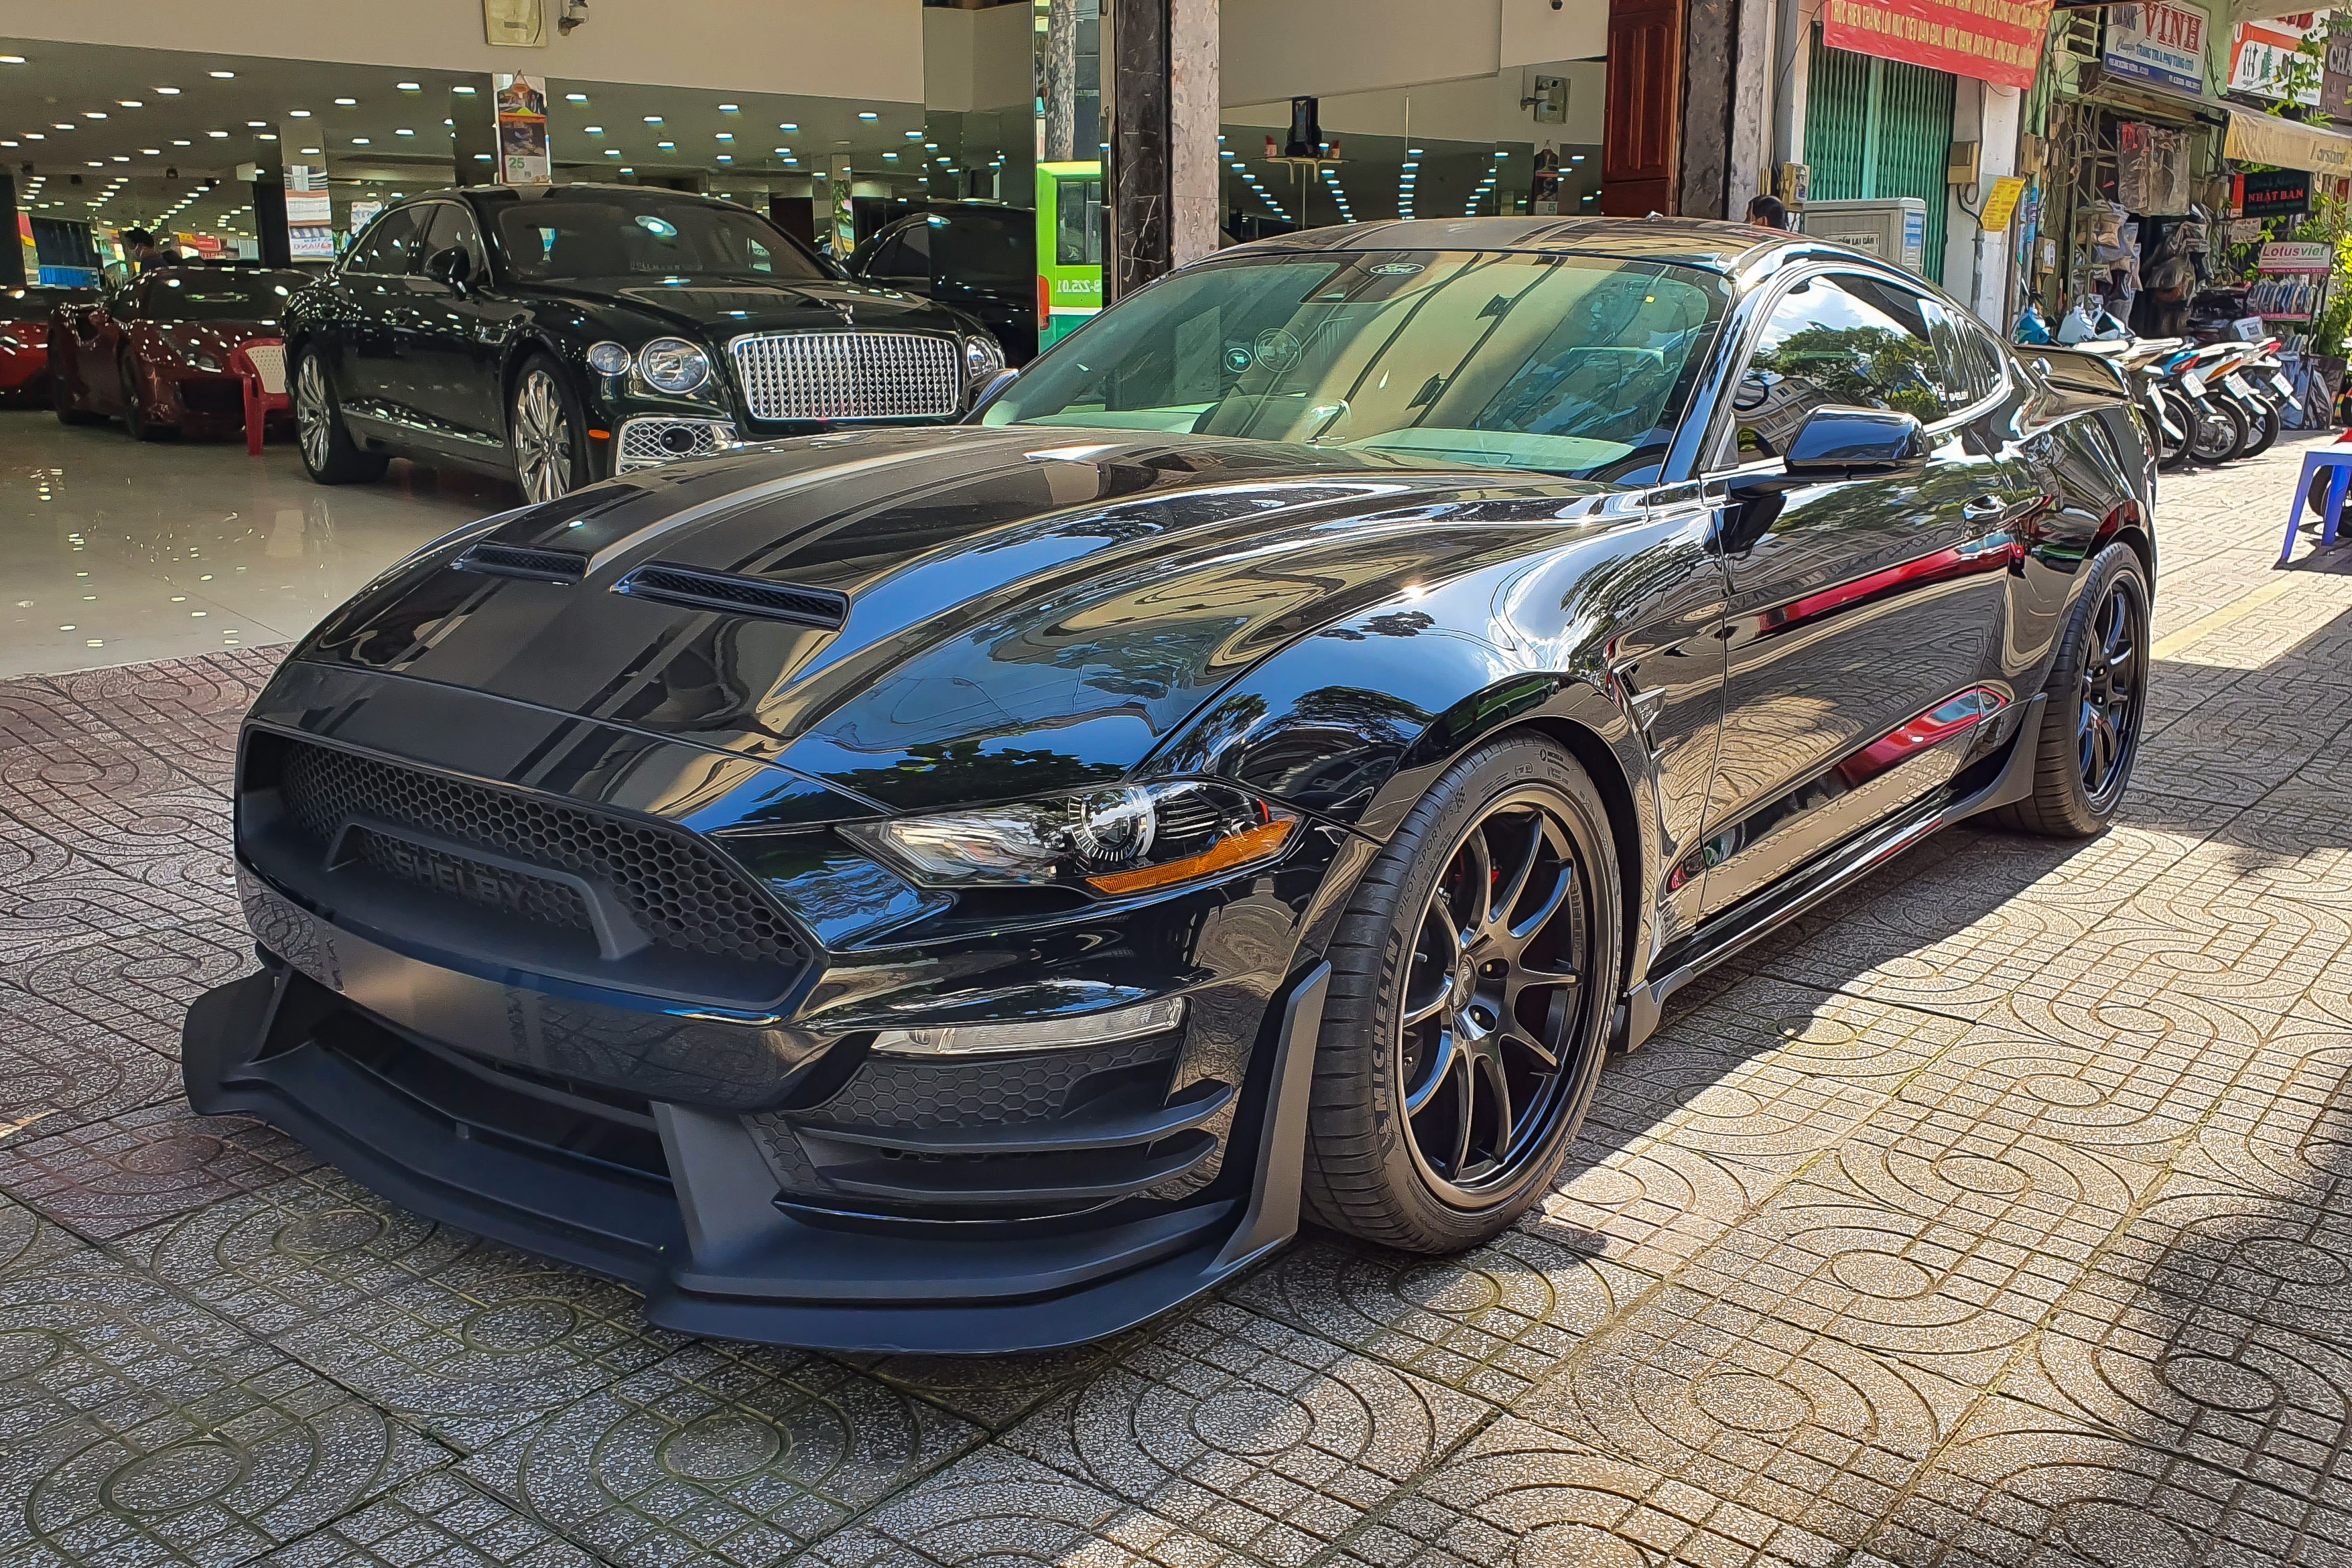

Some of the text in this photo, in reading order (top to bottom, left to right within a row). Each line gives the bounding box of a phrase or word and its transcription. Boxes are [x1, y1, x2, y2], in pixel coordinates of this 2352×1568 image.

[2143, 2, 2203, 55] VINH
[508, 157, 525, 170] 25
[1374, 264, 1421, 273] Ford
[2262, 245, 2325, 257] Lotusviet
[394, 849, 524, 909] SHELBY
[1398, 870, 1417, 917] PILOT
[1417, 821, 1443, 869] SPORT
[1373, 937, 1398, 1111] MICHELIN
